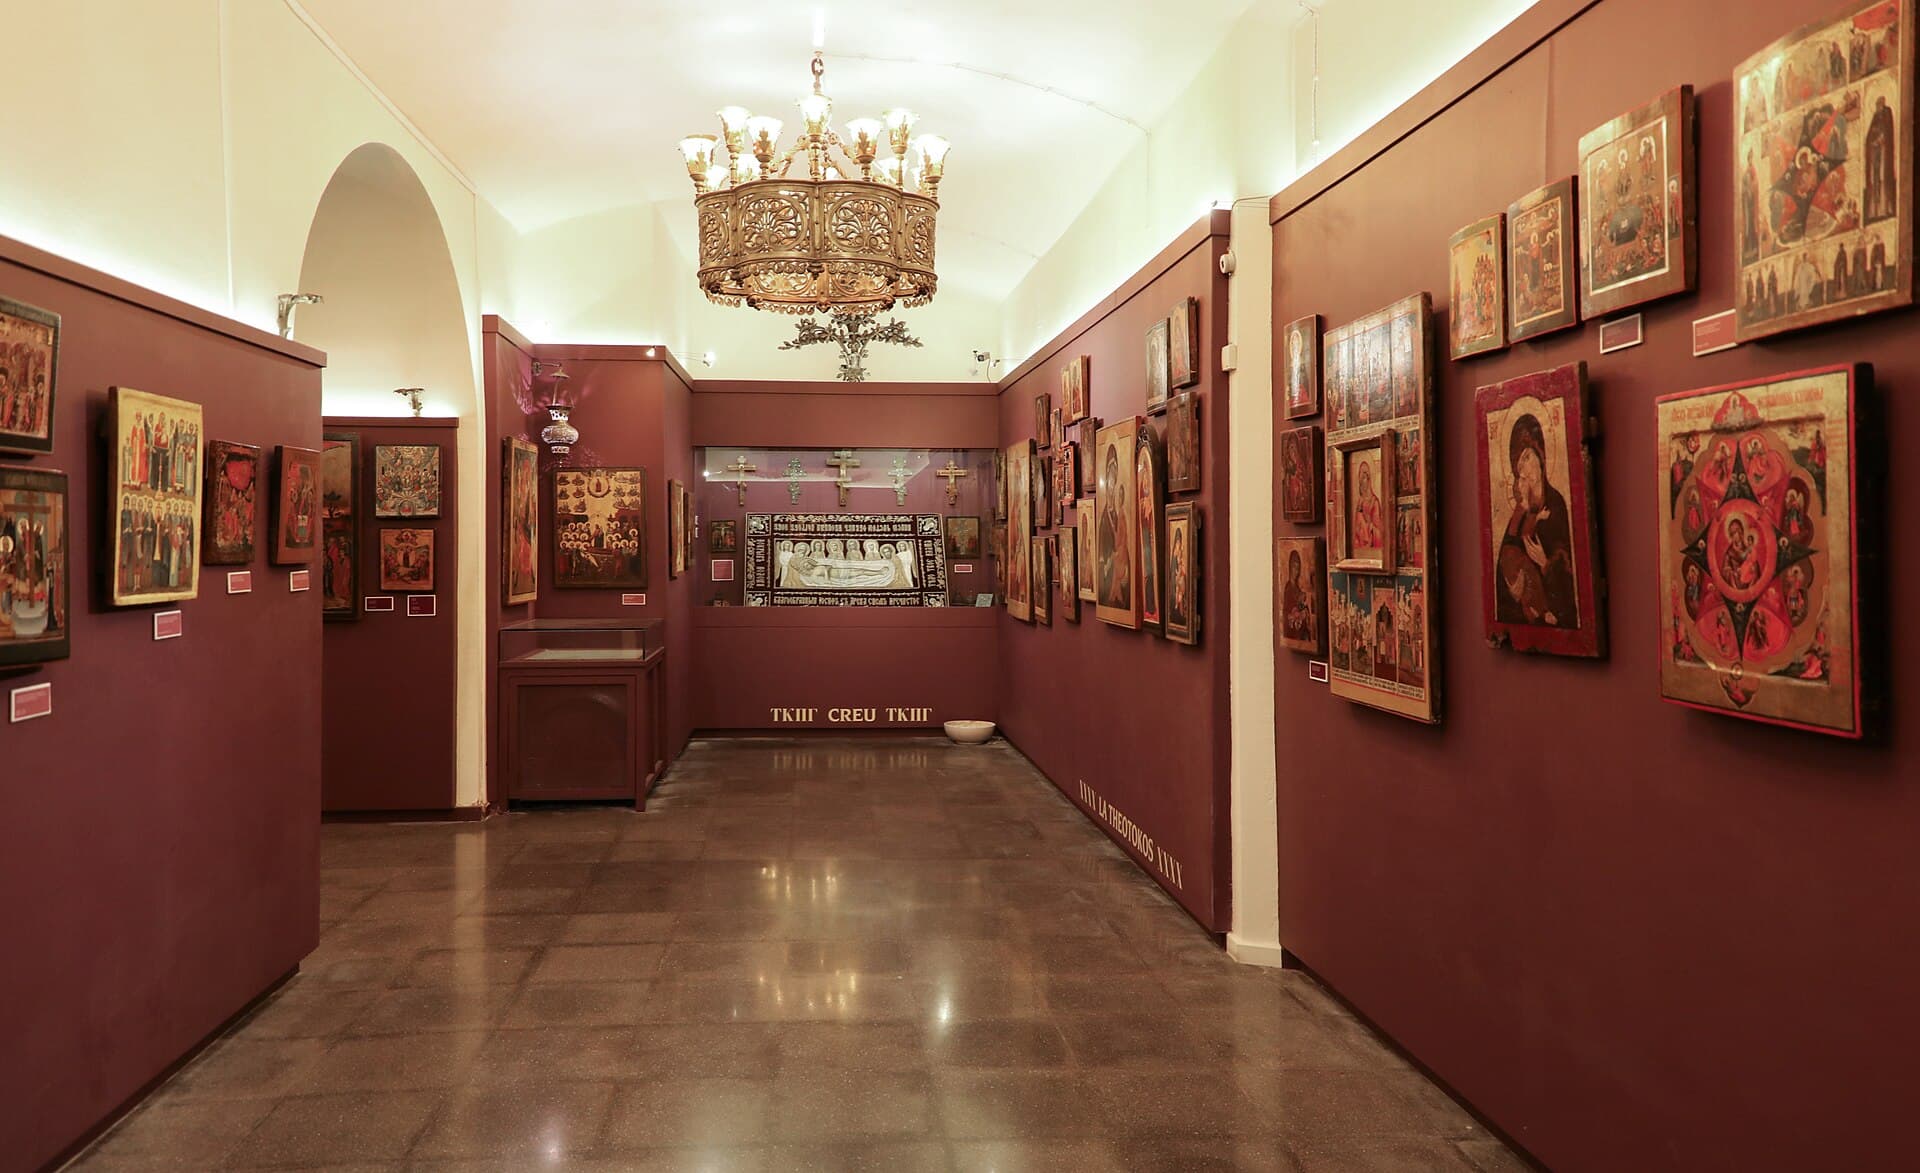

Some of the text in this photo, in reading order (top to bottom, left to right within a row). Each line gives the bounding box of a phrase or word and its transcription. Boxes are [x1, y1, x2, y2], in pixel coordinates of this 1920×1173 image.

[828, 707, 877, 722] CREU
[1098, 795, 1108, 821] LA
[1108, 803, 1154, 863] THEOTOKOS
